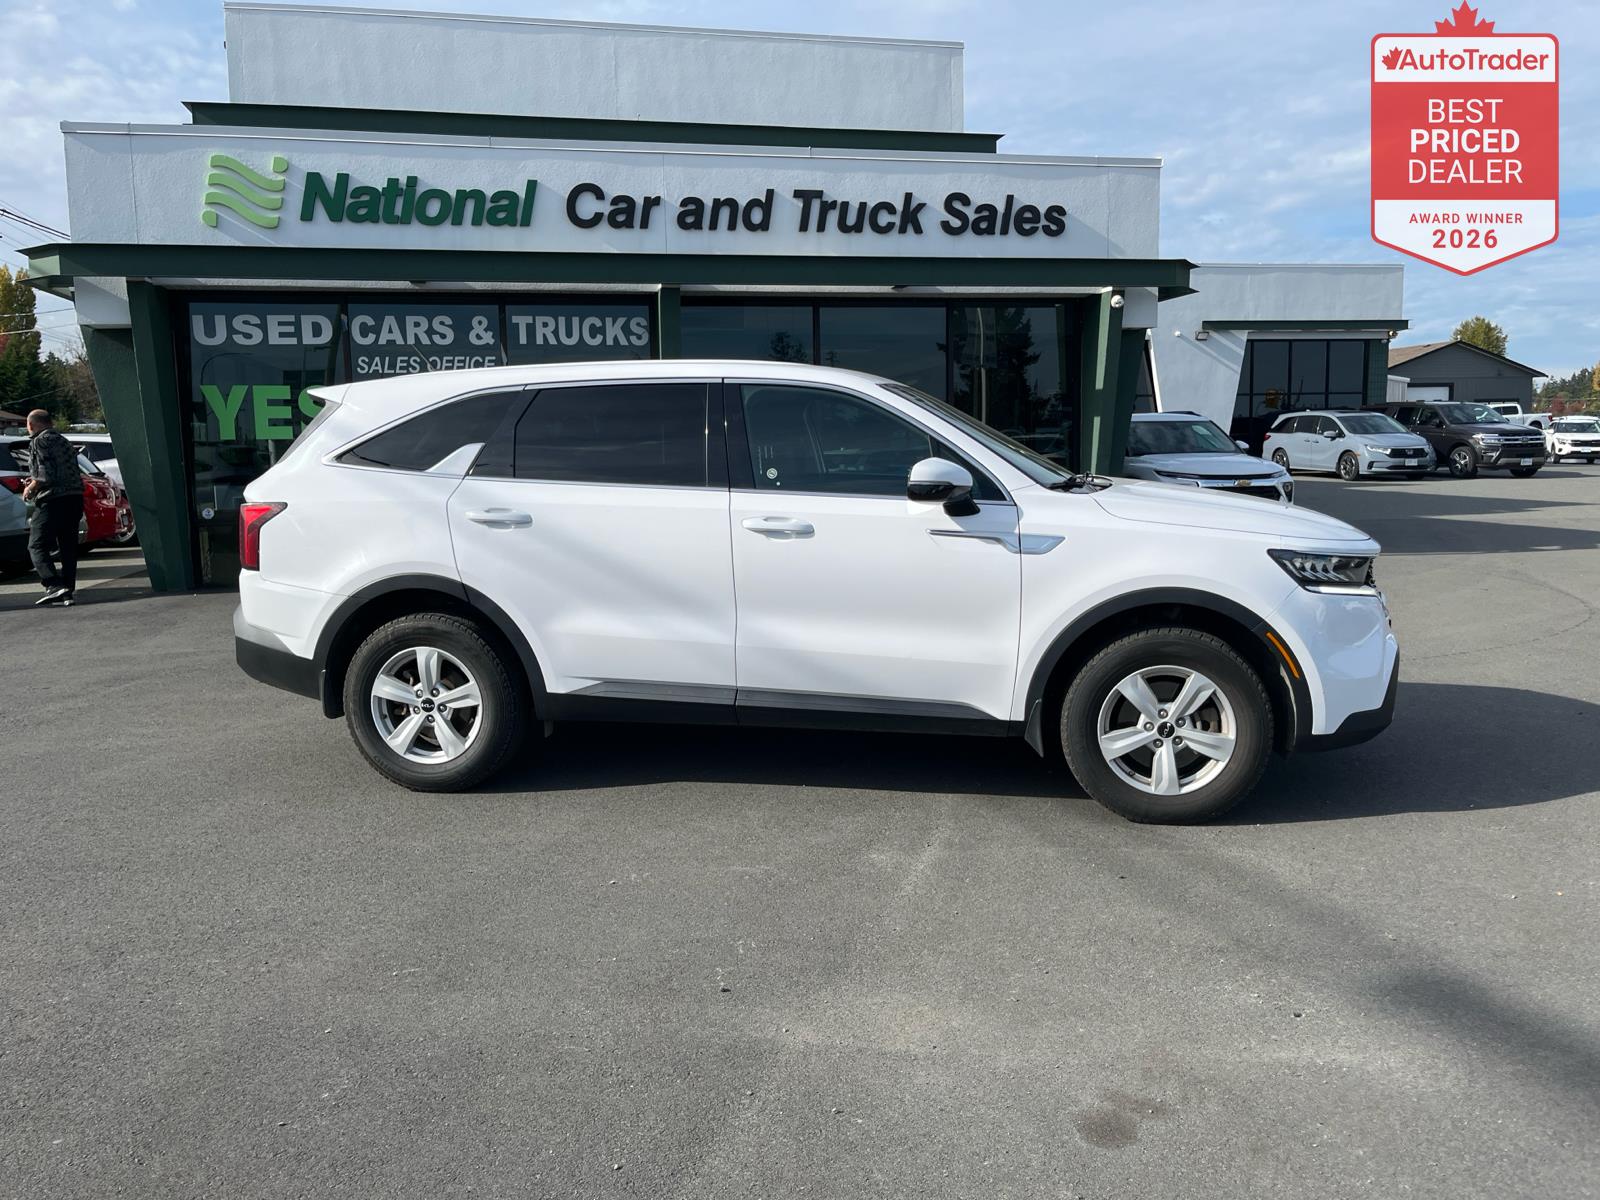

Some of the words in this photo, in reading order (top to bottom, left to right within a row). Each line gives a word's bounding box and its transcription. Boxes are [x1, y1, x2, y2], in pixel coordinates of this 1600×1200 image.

[300, 171, 538, 227] National
[566, 182, 661, 229] Car
[676, 188, 775, 232] and
[793, 188, 927, 235] Truck
[940, 191, 1068, 237] Sales
[191, 314, 333, 346] USED
[350, 314, 455, 346] CARS
[468, 316, 496, 346] &
[511, 315, 650, 346] TRUCKS
[356, 356, 420, 375] SALES
[427, 355, 497, 372] OFFICE
